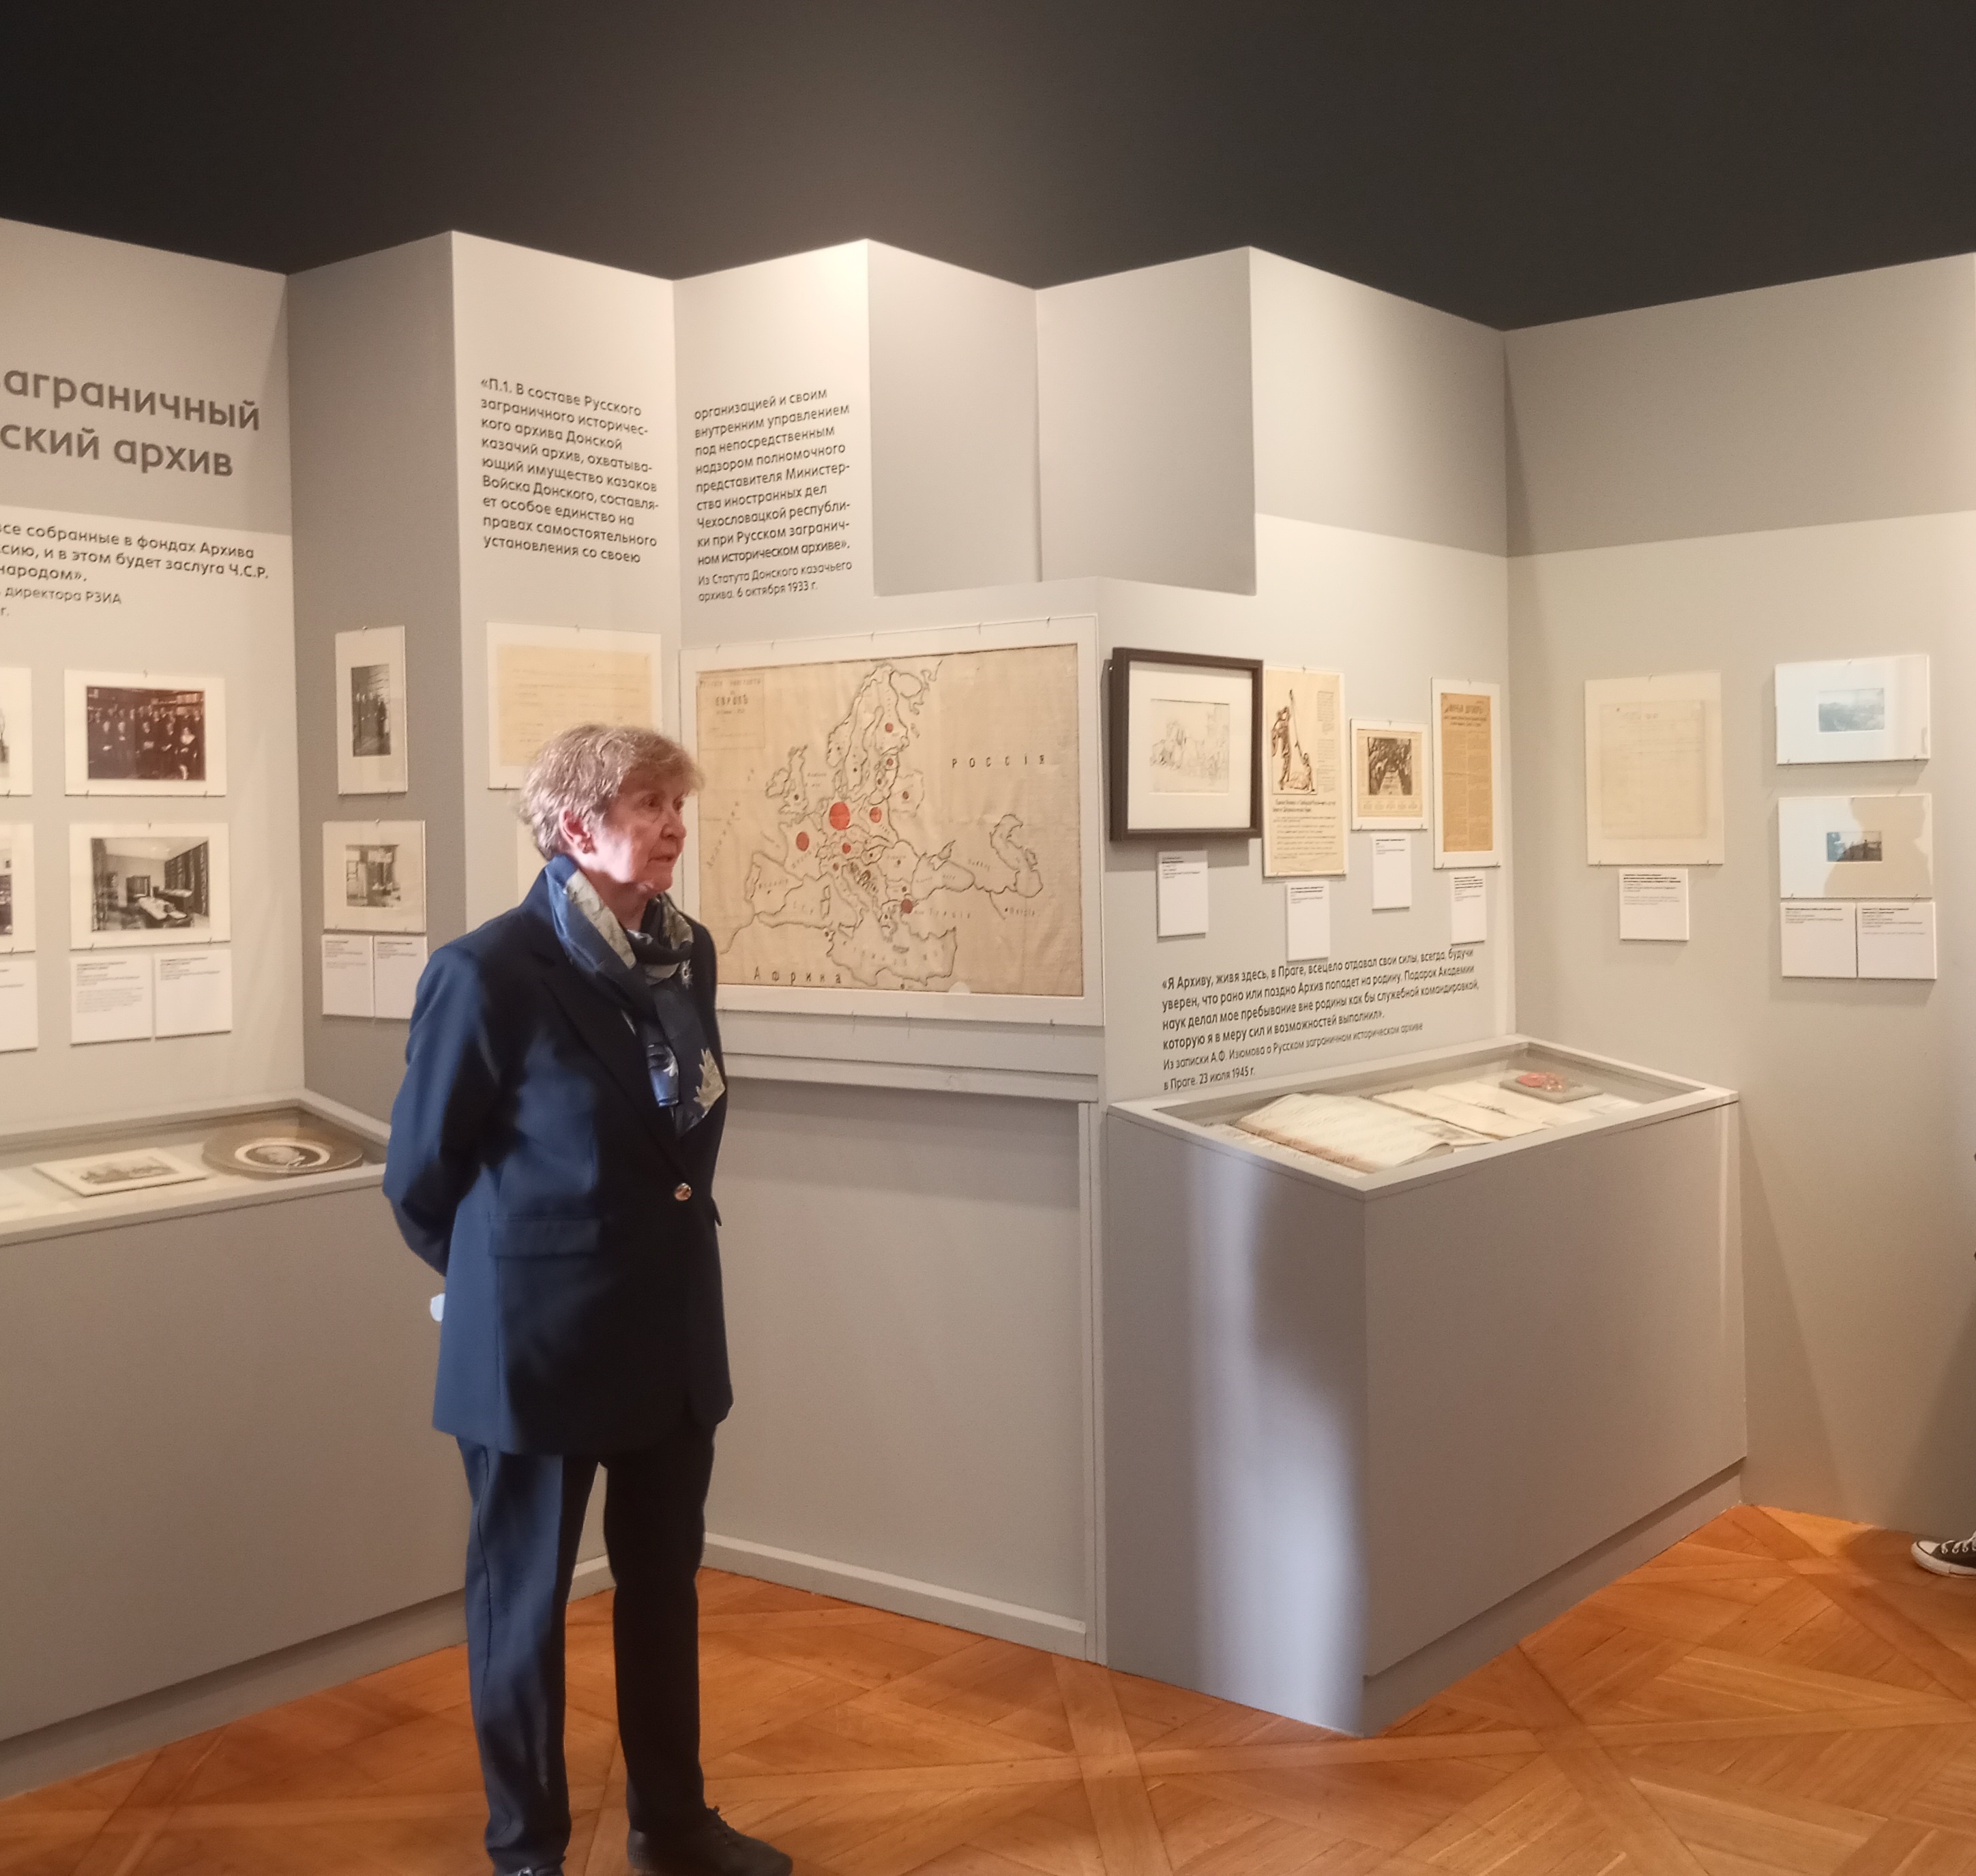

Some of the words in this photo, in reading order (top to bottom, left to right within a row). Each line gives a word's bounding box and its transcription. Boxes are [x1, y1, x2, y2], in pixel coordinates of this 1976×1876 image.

[3, 370, 260, 431] аграничный
[516, 383, 524, 395] В
[528, 388, 580, 405] составе
[585, 396, 641, 416] Русского
[694, 396, 776, 421] организацией
[780, 396, 786, 405] и
[789, 389, 827, 404] своим
[481, 399, 574, 423] заграничного
[578, 415, 648, 435] историчес-
[695, 419, 765, 438] внутренним
[767, 404, 849, 429] управлением
[482, 419, 511, 432] кого
[515, 424, 563, 440] архива
[566, 430, 622, 449] Донской
[695, 445, 716, 456] под
[719, 426, 835, 452] непосредственным
[0, 424, 100, 460] ский
[114, 439, 233, 477] архив
[482, 438, 537, 455] казачий
[542, 448, 584, 464] архив,
[587, 456, 652, 472] охватыва-
[696, 458, 754, 475] надзором
[756, 445, 846, 466] полномочного
[482, 458, 523, 472] ющий
[527, 464, 603, 483] имущество
[607, 477, 657, 492] казаков
[696, 473, 782, 494] представителя
[786, 464, 850, 480] Министер-
[483, 475, 530, 492] Войска
[533, 482, 597, 503] Донского,
[600, 494, 659, 510] составля-
[696, 500, 722, 511] ства
[724, 488, 802, 507] иностранных
[805, 485, 827, 498] дел
[483, 497, 497, 507] ет
[501, 500, 551, 515] особое
[555, 507, 615, 523] единство
[619, 515, 634, 526] на
[697, 507, 786, 528] Чехословацкой
[789, 500, 851, 520] республи-
[0, 524, 21, 535] се
[27, 526, 119, 545] собранные
[125, 537, 132, 546] в
[137, 535, 196, 552] фондах
[200, 542, 254, 558] Архива
[483, 516, 533, 531] правах
[537, 523, 657, 546] самостоятельного
[697, 537, 710, 547] ки
[713, 535, 734, 547] при
[737, 528, 786, 544] Русском
[789, 520, 850, 537] загранич-
[0, 545, 39, 559] сию,
[44, 548, 53, 559] и
[59, 550, 67, 560] в
[72, 551, 110, 564] этом
[116, 553, 161, 569] будет
[166, 560, 224, 576] заслуга
[229, 564, 269, 579] Ч.С.Р.
[484, 536, 578, 556] установления
[583, 548, 597, 558] со
[601, 550, 640, 563] своею
[698, 554, 720, 565] ном
[722, 546, 799, 563] историческом
[801, 540, 850, 556] архиве».
[698, 576, 709, 586] Из
[712, 573, 750, 584] Статута
[752, 567, 798, 582] Донского
[801, 562, 852, 575] казачьего
[737, 587, 743, 597] 6
[746, 584, 786, 597] октября
[788, 580, 809, 593] 1933
[5, 587, 81, 602] директора
[86, 591, 121, 604] РЗИА
[1162, 977, 1175, 989] «Я
[1177, 976, 1213, 990] Архиву,
[1216, 972, 1239, 985] живя
[1241, 970, 1269, 982] здесь,
[1271, 969, 1276, 978] в
[1278, 965, 1306, 979] Праге,
[1308, 962, 1343, 974] всецело
[1344, 958, 1377, 970] отдавал
[1378, 956, 1396, 966] свои
[1448, 948, 1473, 961] будучи
[1162, 998, 1200, 1013] уверен,
[1202, 994, 1218, 1005] что
[1220, 991, 1243, 1005] рано
[1246, 990, 1262, 1000] или
[1265, 985, 1296, 998] поздно
[1298, 982, 1323, 995] Архив
[1325, 978, 1359, 990] попадет
[1361, 977, 1371, 986] на
[1405, 969, 1436, 981] Подарок
[1439, 965, 1475, 977] Академии
[1162, 1017, 1186, 1031] наук
[1188, 1013, 1218, 1028] делал
[1220, 1011, 1239, 1022] мое
[1241, 1004, 1296, 1021] пребывание
[1299, 1001, 1313, 1012] вне
[1315, 998, 1347, 1011] родины
[1349, 995, 1363, 1005] как
[1364, 991, 1376, 1003] бы
[1377, 986, 1419, 1002] служебной
[1163, 1034, 1205, 1050] которую
[1207, 1033, 1213, 1043] я
[1215, 1032, 1220, 1043] в
[1223, 1028, 1247, 1042] меру
[1249, 1026, 1265, 1038] сил
[1267, 1025, 1272, 1035] и
[1274, 1014, 1337, 1034] возможностей
[1164, 1059, 1174, 1071] Из
[1176, 1055, 1209, 1069] записки
[1229, 1047, 1265, 1060] Изюмова
[1267, 1045, 1271, 1054] о
[1273, 1041, 1304, 1054] Русском
[1164, 1082, 1168, 1090] в
[1199, 1073, 1208, 1084] 23
[1210, 1071, 1230, 1083] июля
[1232, 1065, 1249, 1078] 1945
